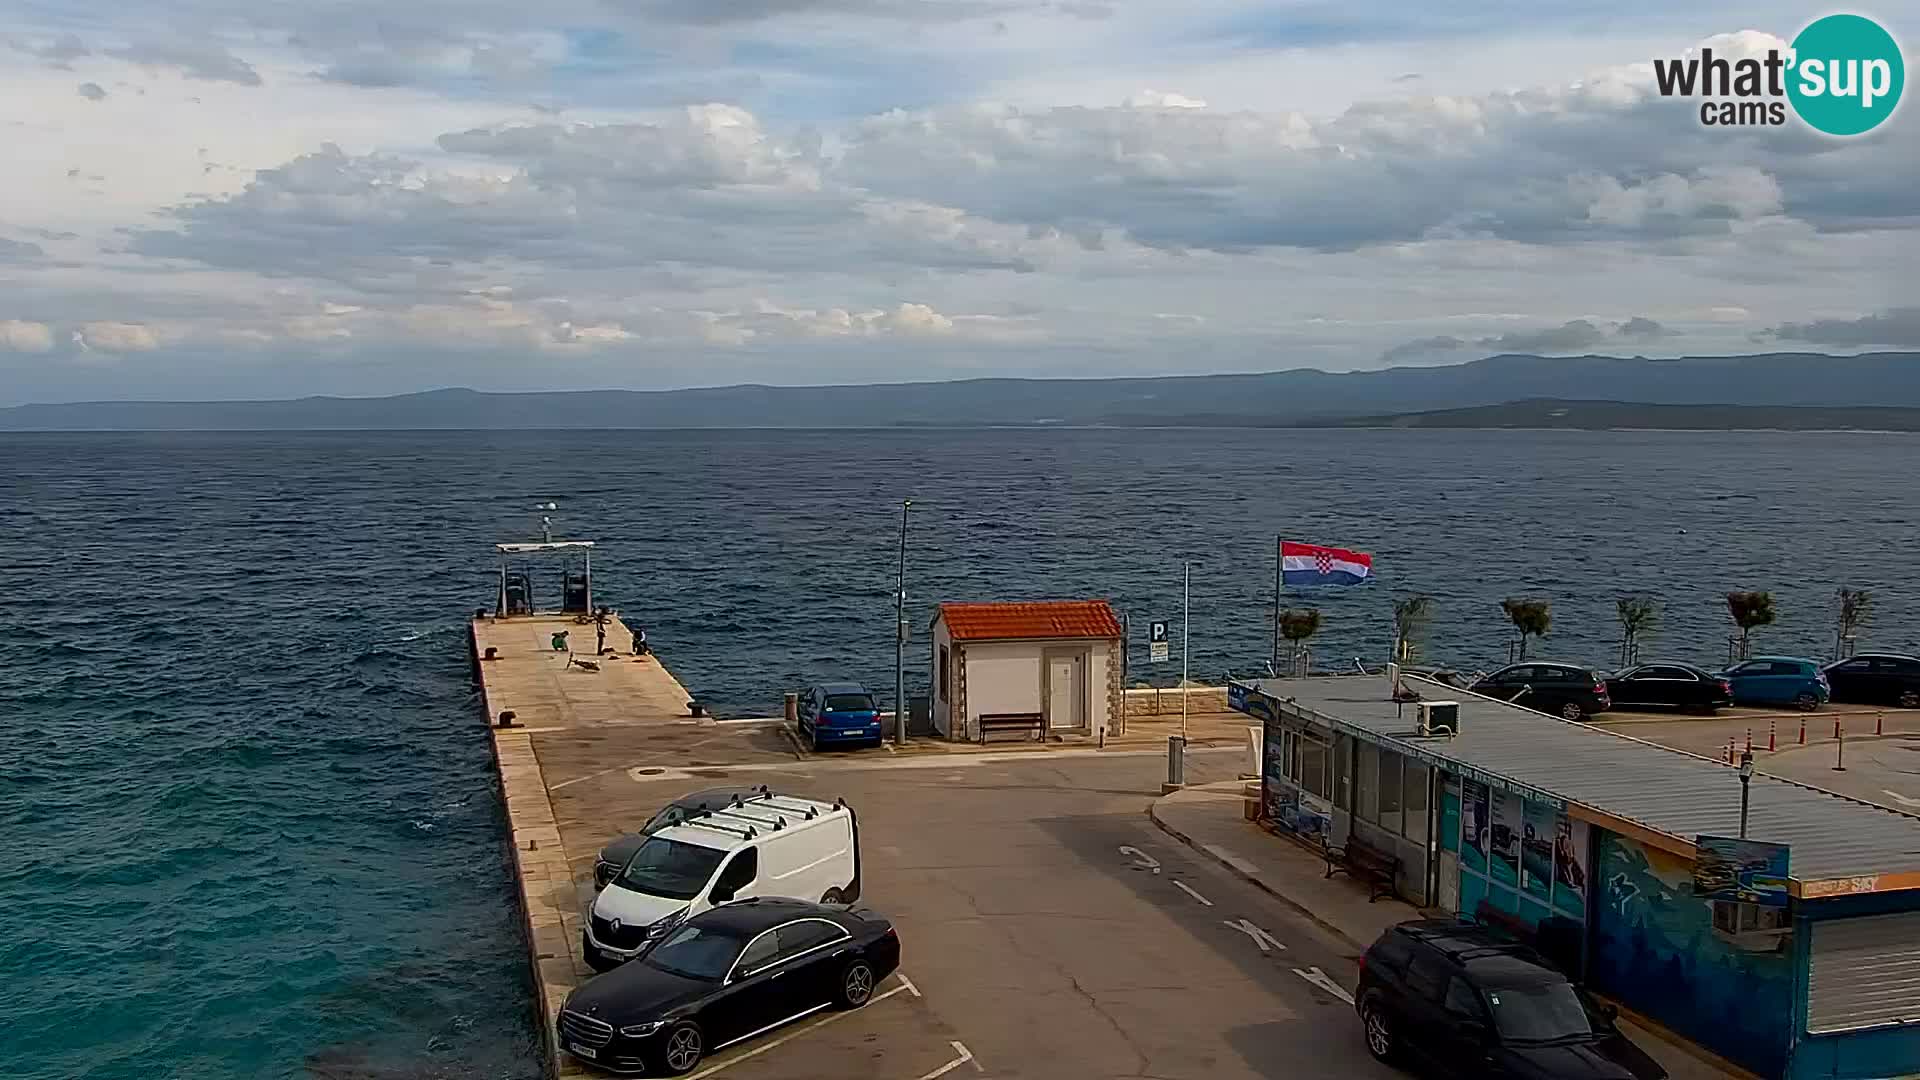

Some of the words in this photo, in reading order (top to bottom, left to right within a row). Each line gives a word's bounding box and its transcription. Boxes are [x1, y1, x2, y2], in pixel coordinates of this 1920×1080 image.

[1153, 623, 1165, 640] P
[1458, 764, 1473, 778] BUS
[1507, 782, 1535, 801] TICKET
[1535, 793, 1562, 809] OFFICE
